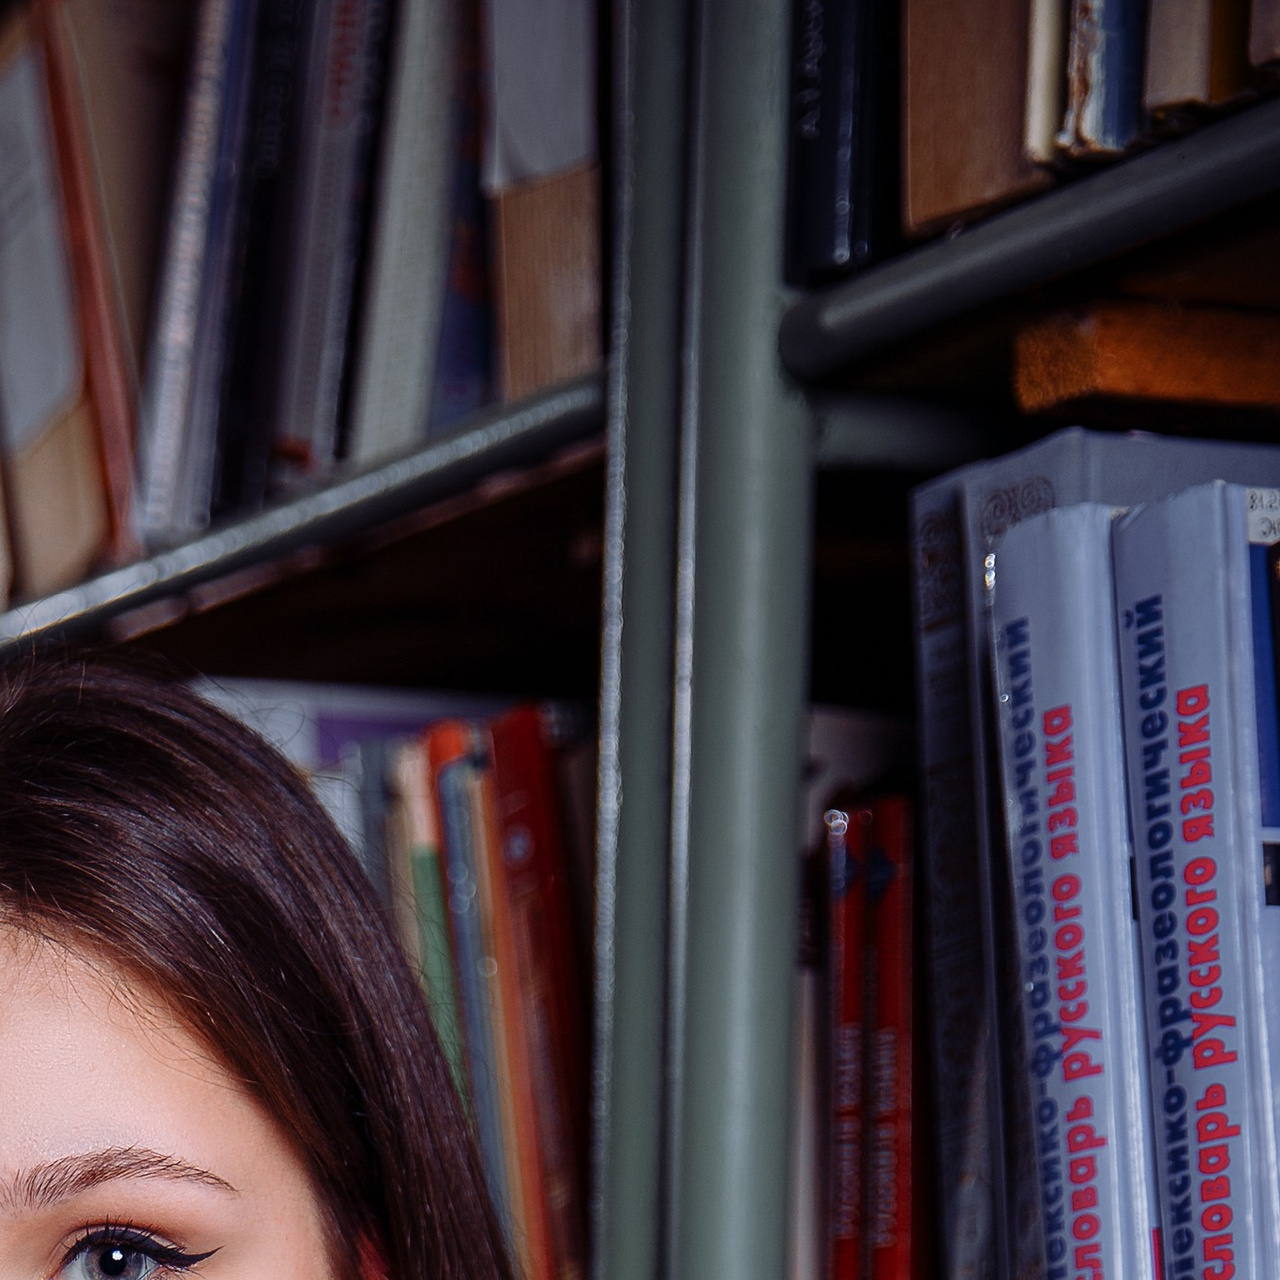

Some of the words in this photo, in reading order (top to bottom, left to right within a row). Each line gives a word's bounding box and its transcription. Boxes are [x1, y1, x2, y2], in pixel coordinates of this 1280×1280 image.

[1043, 704, 1080, 863] языка
[1177, 683, 1216, 844] языка
[1052, 873, 1105, 1084] русского
[1184, 856, 1239, 1071] русского
